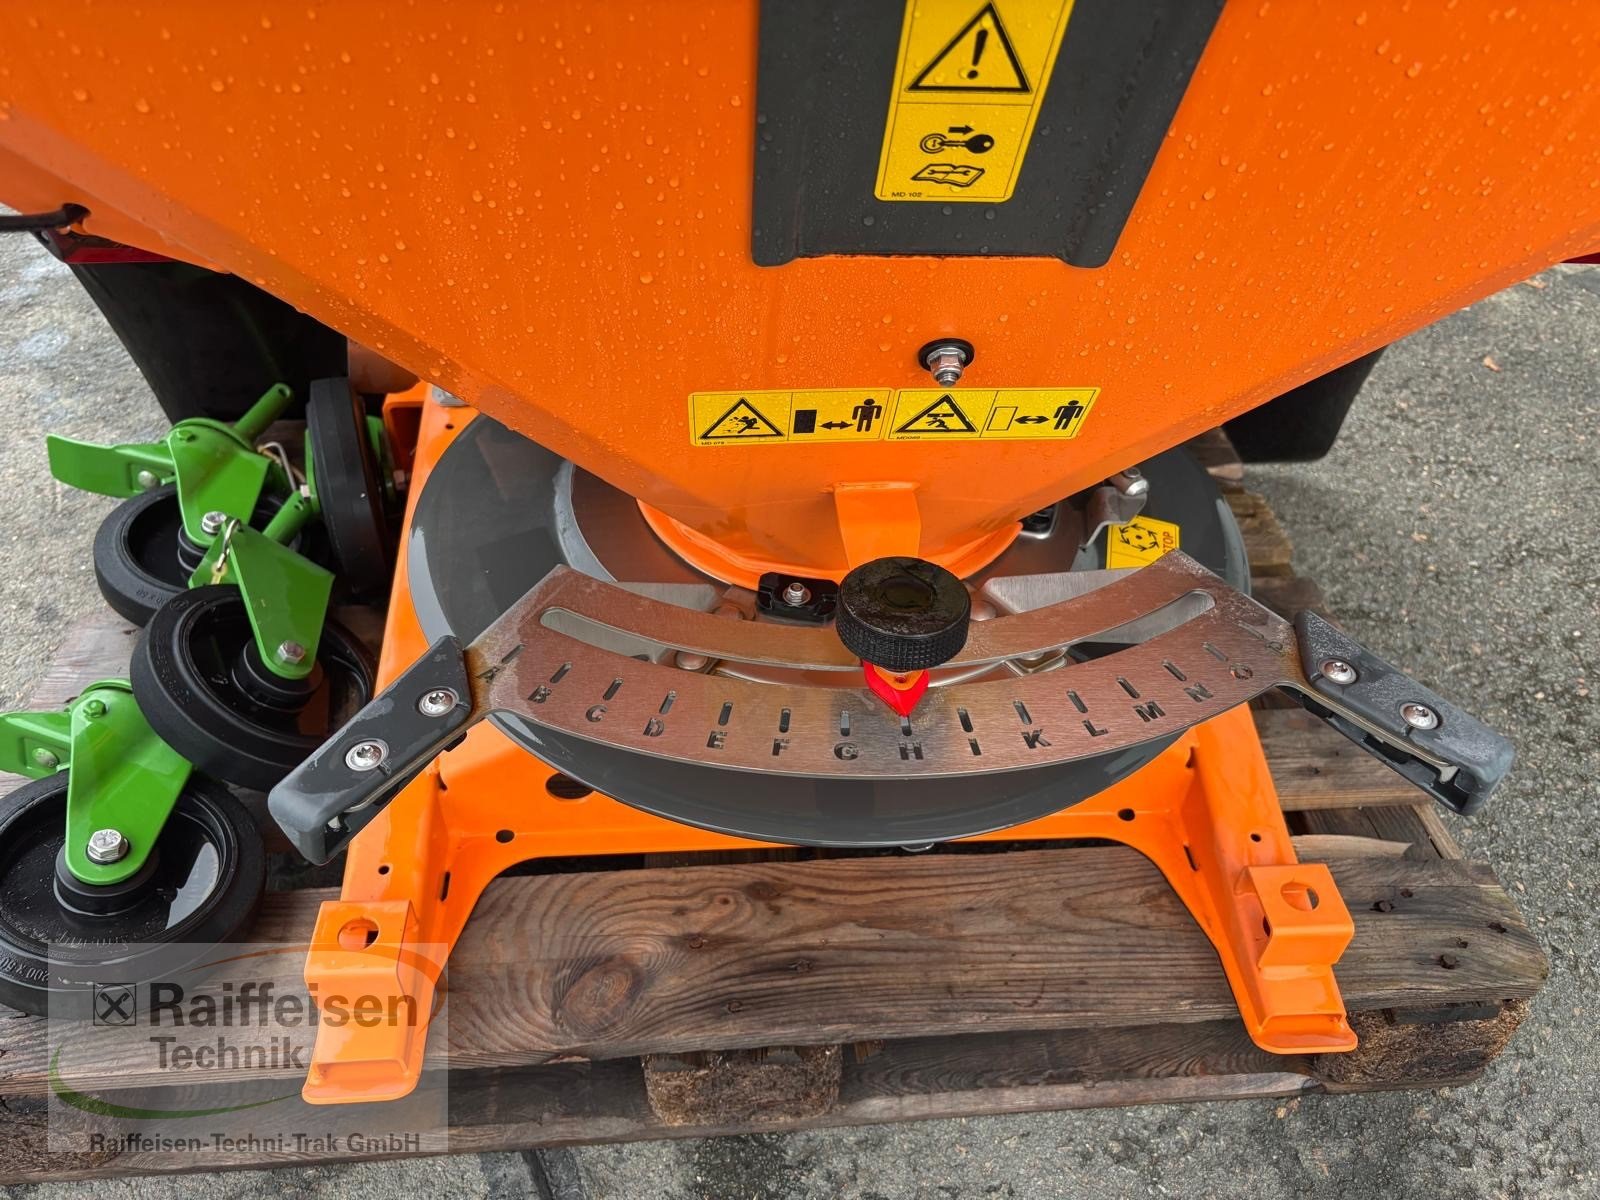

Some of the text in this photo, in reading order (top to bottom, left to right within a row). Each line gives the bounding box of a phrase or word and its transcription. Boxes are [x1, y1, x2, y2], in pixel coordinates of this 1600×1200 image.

[527, 684, 553, 704] B
[585, 704, 609, 723] C
[643, 717, 665, 737] D
[706, 731, 728, 750] E
[772, 738, 791, 756] F
[833, 741, 861, 761] G
[898, 741, 925, 761] H
[968, 737, 982, 756] I
[1021, 728, 1052, 750] K
[1081, 719, 1109, 737] L
[1133, 700, 1167, 723] M
[1184, 683, 1214, 702] N
[1229, 662, 1254, 681] O
